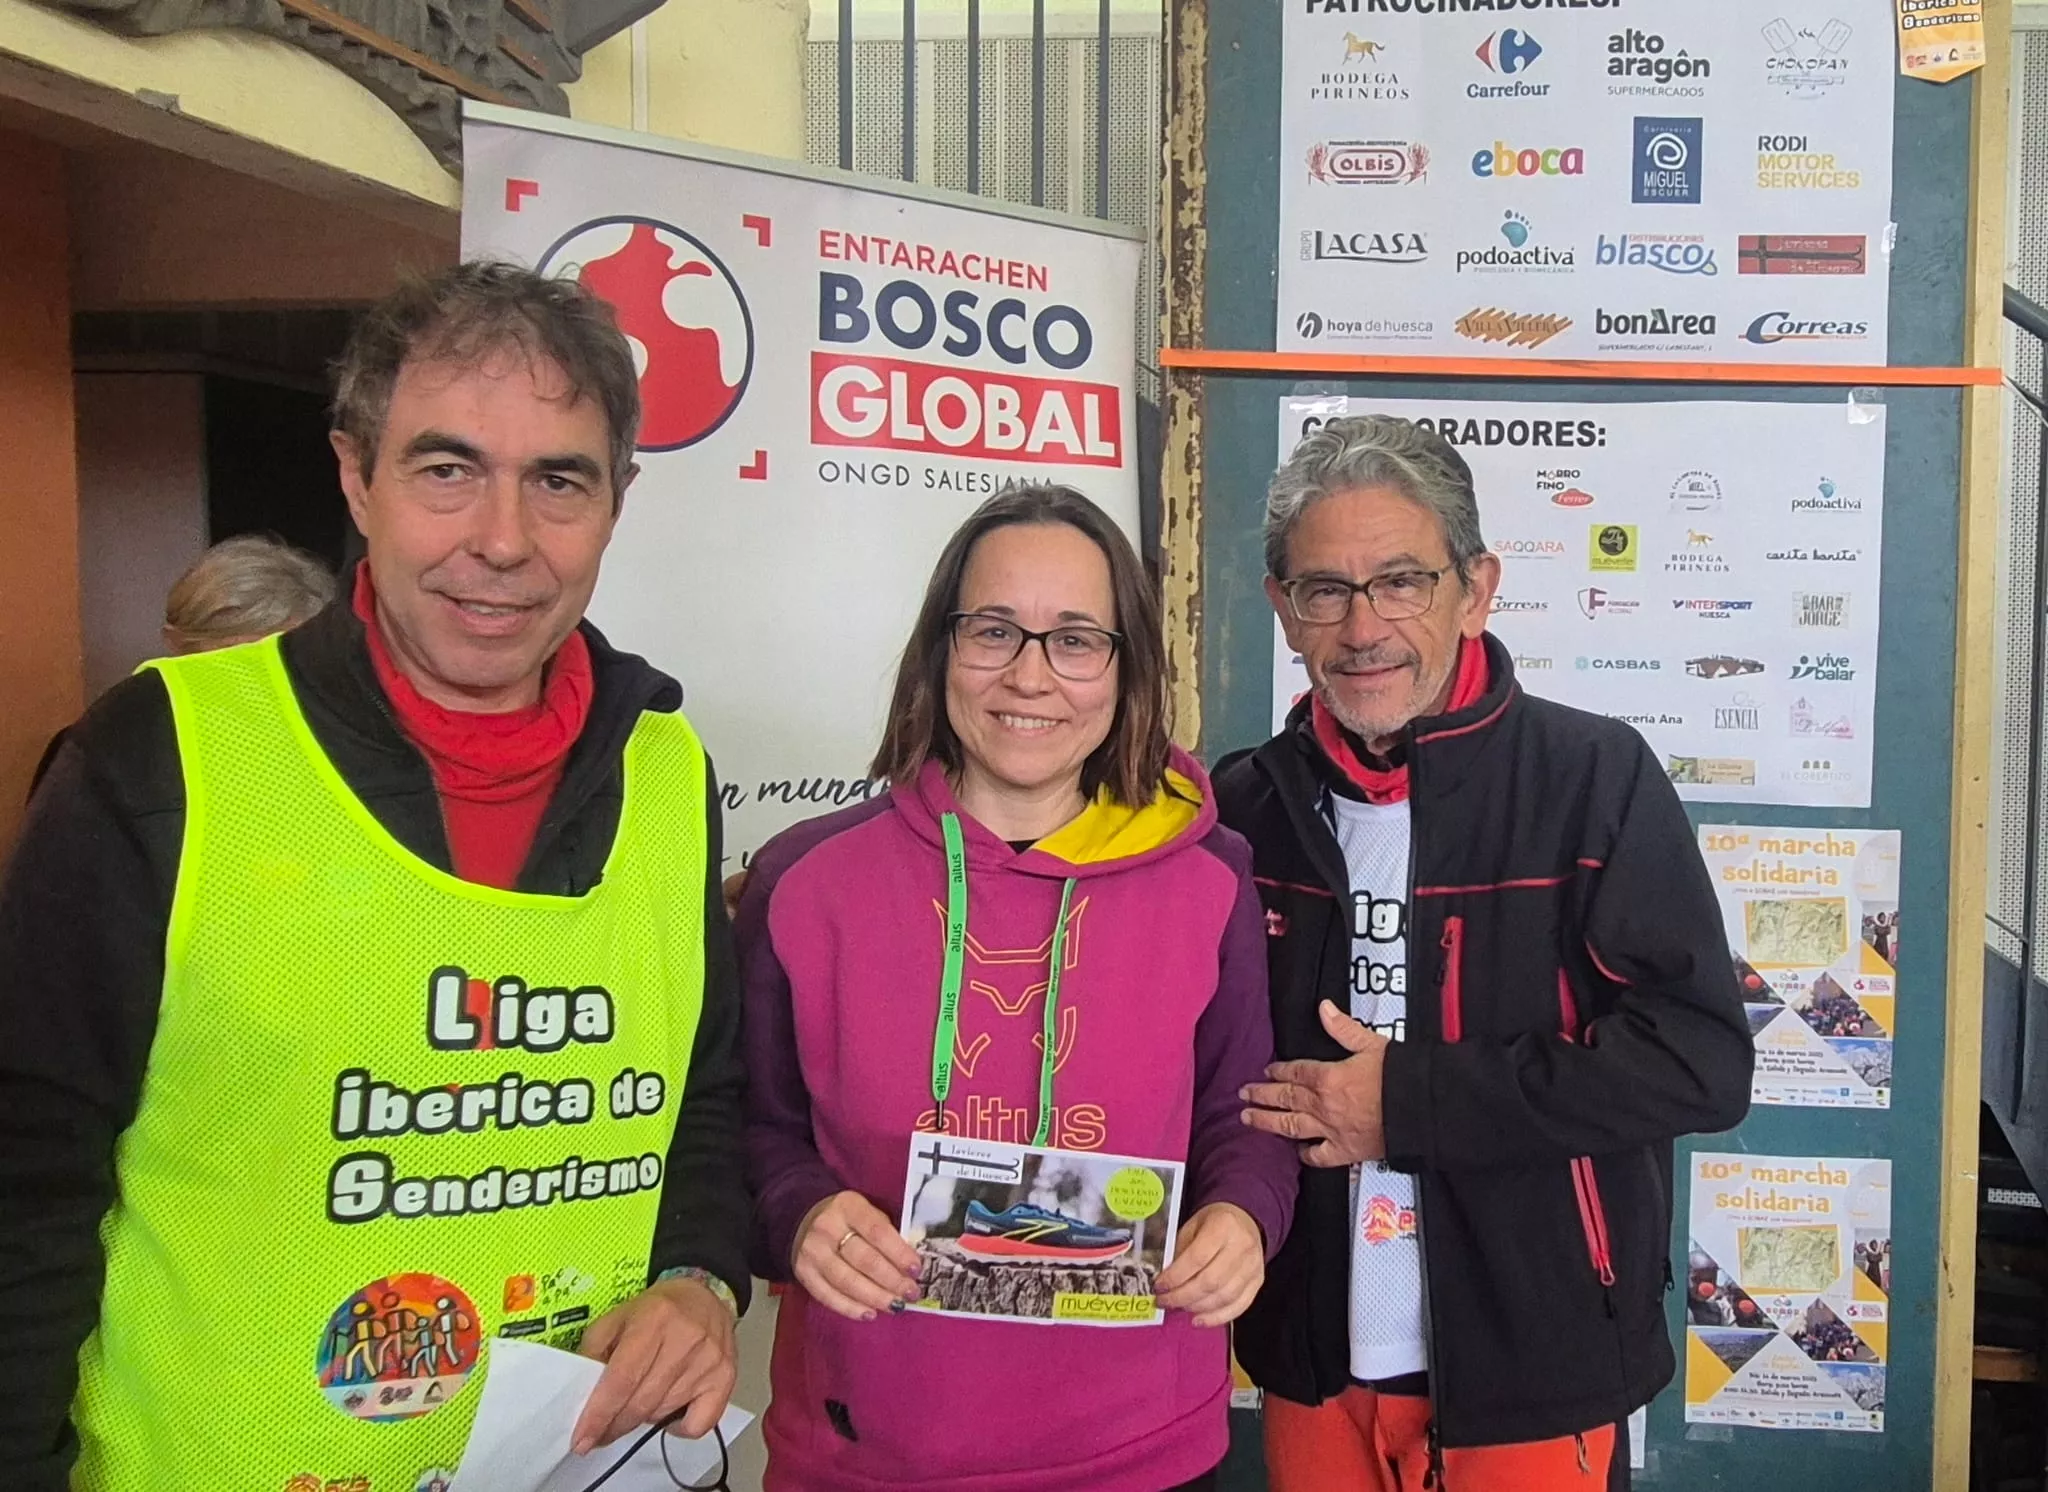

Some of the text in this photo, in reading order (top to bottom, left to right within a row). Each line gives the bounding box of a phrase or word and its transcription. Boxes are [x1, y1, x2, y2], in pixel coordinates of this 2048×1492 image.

[1607, 28, 1665, 54] alto
[1766, 57, 1849, 70] CHOKOPAN
[1321, 73, 1399, 84] BODEGA
[1466, 81, 1550, 98] Carrefour
[1311, 87, 1410, 100] PIRINEOS
[1607, 86, 1705, 97] SUPERMERCADOS
[1757, 135, 1808, 152] RODI
[1471, 140, 1584, 178] eboca
[1757, 153, 1835, 170] MOTOR
[1643, 171, 1689, 188] MIGUEL
[1756, 171, 1860, 189] SERVICES
[1300, 229, 1428, 261] GRUPO LACASA
[1596, 234, 1712, 270] blasco
[819, 231, 1048, 292] ENTARACHEN
[1457, 246, 1574, 273] podoactiva
[818, 271, 1093, 370] BOSCO
[1327, 318, 1362, 337] hoya
[1364, 318, 1381, 332] de
[1383, 319, 1433, 332] huesca
[1745, 311, 1868, 344] Correas
[818, 364, 1116, 458] GLOBAL
[1302, 416, 1606, 446] CORADORES:
[818, 460, 910, 487] ONGD
[1536, 481, 1565, 491] FINO
[1791, 497, 1862, 512] podoactiva
[1495, 541, 1565, 553] SAQQARA
[1671, 554, 1723, 563] BODEGA
[1664, 563, 1731, 573] PIRINEOS
[1685, 600, 1753, 610] INTERSPORT
[1811, 595, 1834, 610] BAR
[1699, 611, 1731, 619] HUESCA
[1799, 611, 1841, 627] JORGE
[1592, 658, 1661, 670] CASBAS
[1816, 653, 1850, 667] vive
[1814, 667, 1857, 681] balar
[1659, 713, 1683, 724] Ana
[1715, 707, 1760, 730] ESENCIA
[1759, 833, 1856, 857] marcha
[953, 853, 962, 884] altus
[1722, 860, 1839, 886] solidaria
[952, 923, 963, 952] altus
[428, 965, 615, 1053] Liga
[945, 992, 957, 1022] altus
[937, 1062, 949, 1093] altus
[331, 1067, 666, 1140] iberica de
[916, 1095, 1106, 1149] altus
[1751, 1162, 1848, 1186] marcha
[327, 1151, 663, 1225] Senderismo
[1715, 1188, 1832, 1213] solidaria
